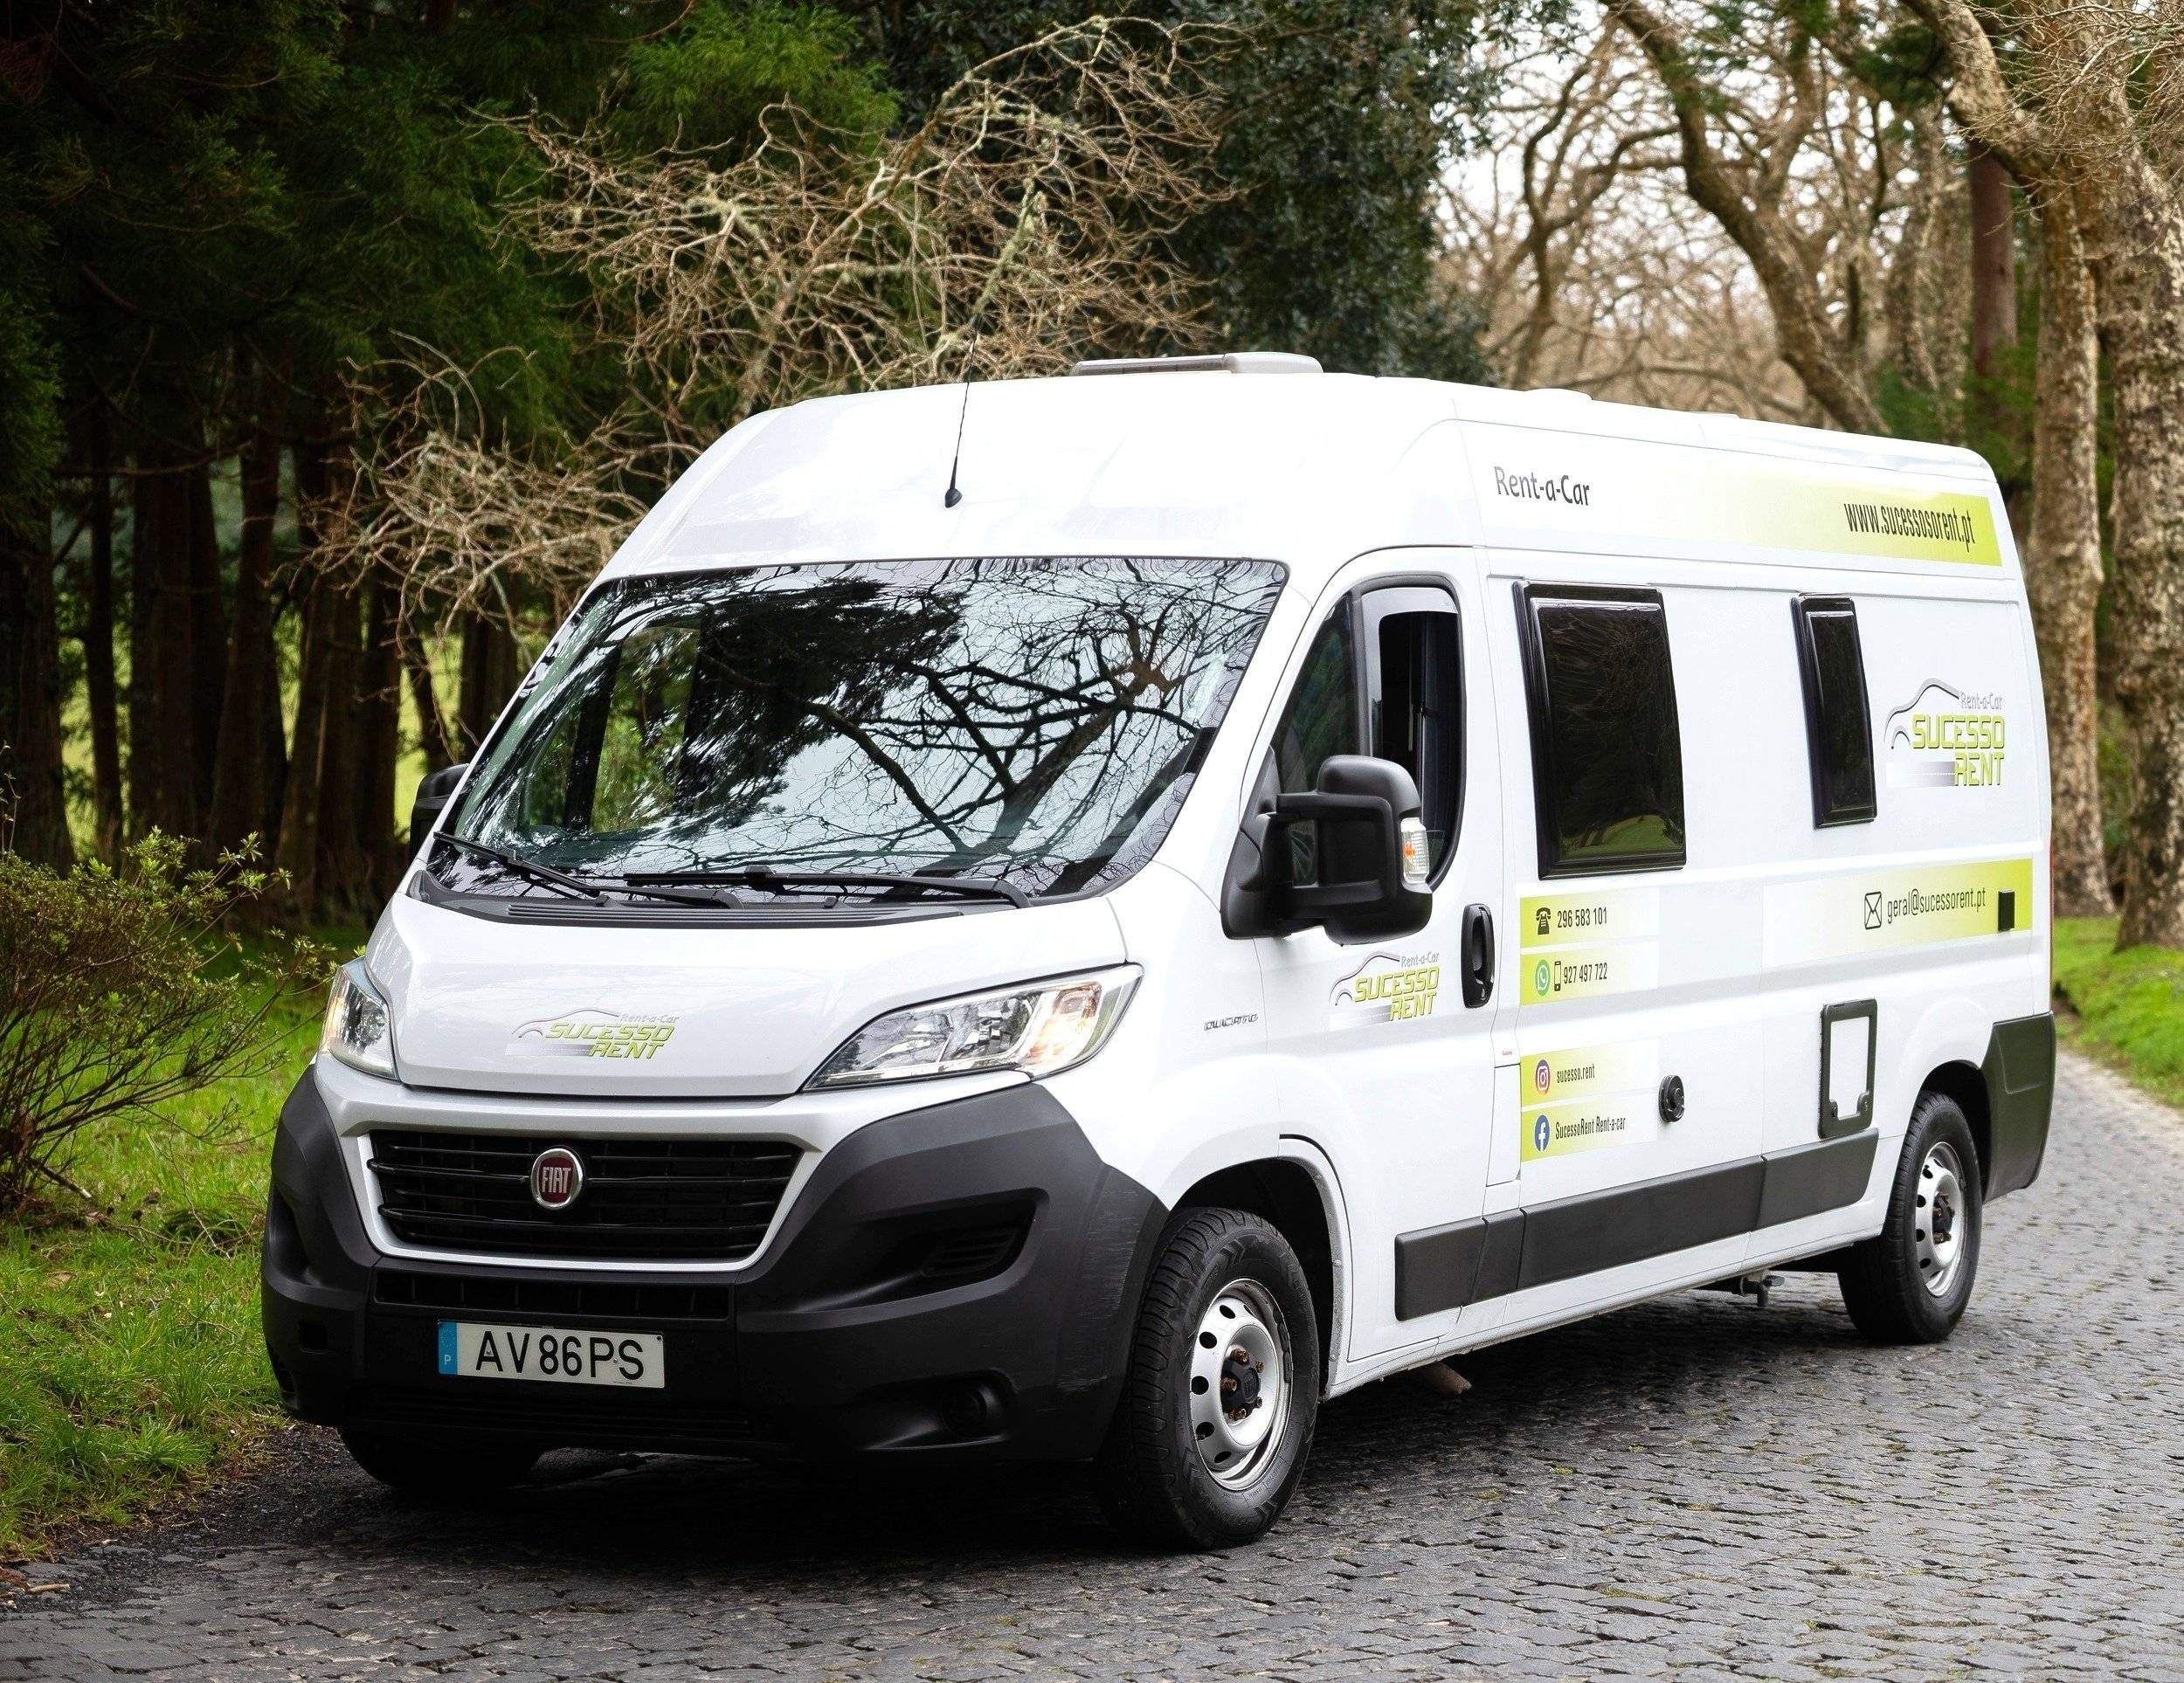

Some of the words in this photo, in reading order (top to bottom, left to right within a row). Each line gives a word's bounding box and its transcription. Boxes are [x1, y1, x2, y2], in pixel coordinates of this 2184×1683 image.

[1494, 466, 1590, 506] Rent-a-Car
[1843, 502, 1976, 553] www.sucessosorent.pt
[1960, 692, 2004, 710] Rent-a-Car
[1912, 714, 2005, 749] SUCESSO
[1954, 752, 2005, 787] RENT
[1887, 886, 1986, 924] geral@sucessorent.pt
[1557, 909, 1573, 928] 296
[1575, 907, 1591, 927] 583
[1593, 907, 1607, 925] 101
[1401, 951, 1440, 968] Rent-a-Car
[1354, 966, 1441, 1003] SUCESSO
[1563, 965, 1577, 984] 927
[1579, 964, 1593, 983] 497
[1594, 962, 1608, 980] 722
[620, 1012, 680, 1024] Rent-a-Car
[1389, 991, 1437, 1022] RENT
[545, 1022, 675, 1042] SUCESSO
[588, 1040, 665, 1059] RENT
[1556, 1064, 1595, 1084] sucesso.rent
[1555, 1118, 1595, 1140] SucessoRent
[1595, 1116, 1626, 1134] Rent-a-car
[542, 1166, 571, 1194] FIAT
[444, 1354, 452, 1366] P
